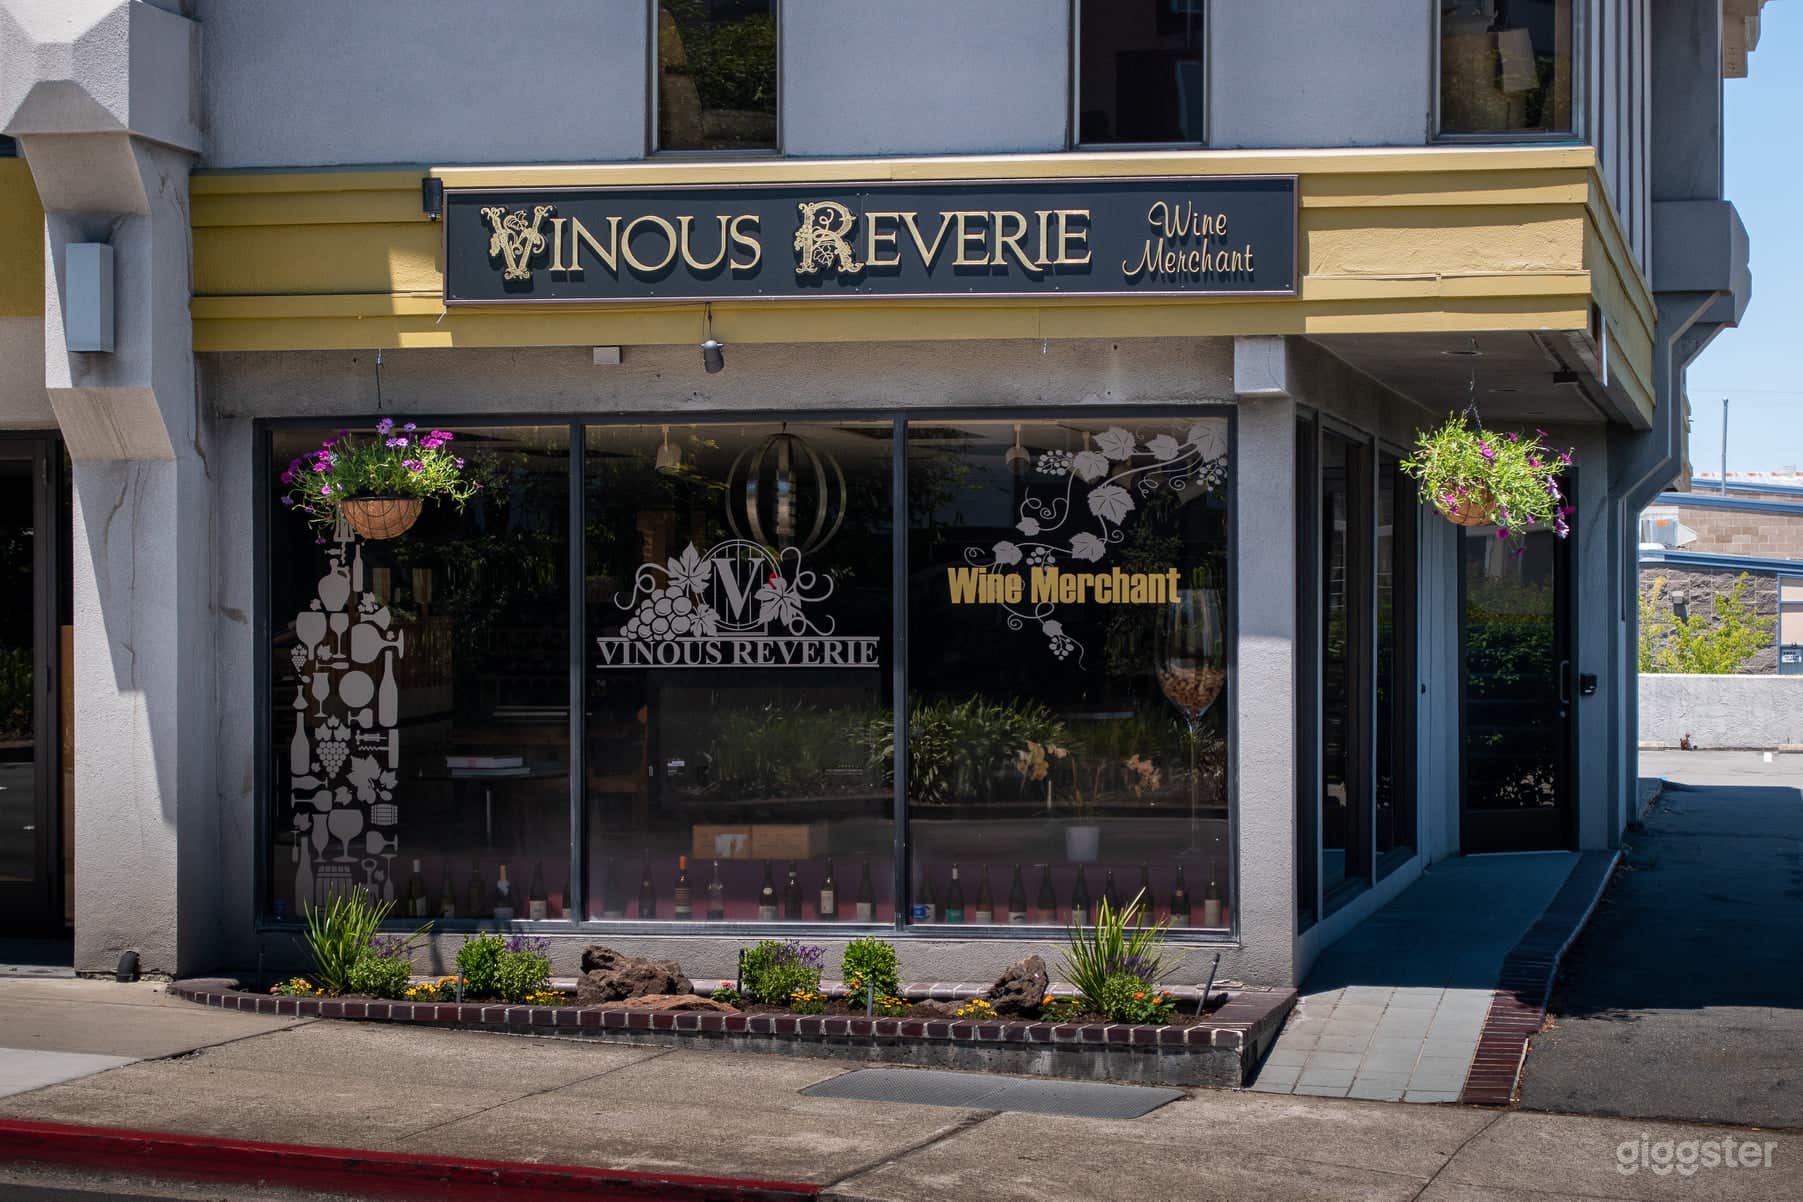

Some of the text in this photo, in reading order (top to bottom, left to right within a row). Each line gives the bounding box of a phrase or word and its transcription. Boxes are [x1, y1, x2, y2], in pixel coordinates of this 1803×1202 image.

[1148, 200, 1228, 238] Wine
[480, 200, 1092, 280] VINOUS REVERIE
[1121, 238, 1255, 276] Merchant
[711, 557, 766, 621] V
[947, 567, 1182, 604] Wine Merchant
[599, 640, 880, 665] VINOUS REVERIE
